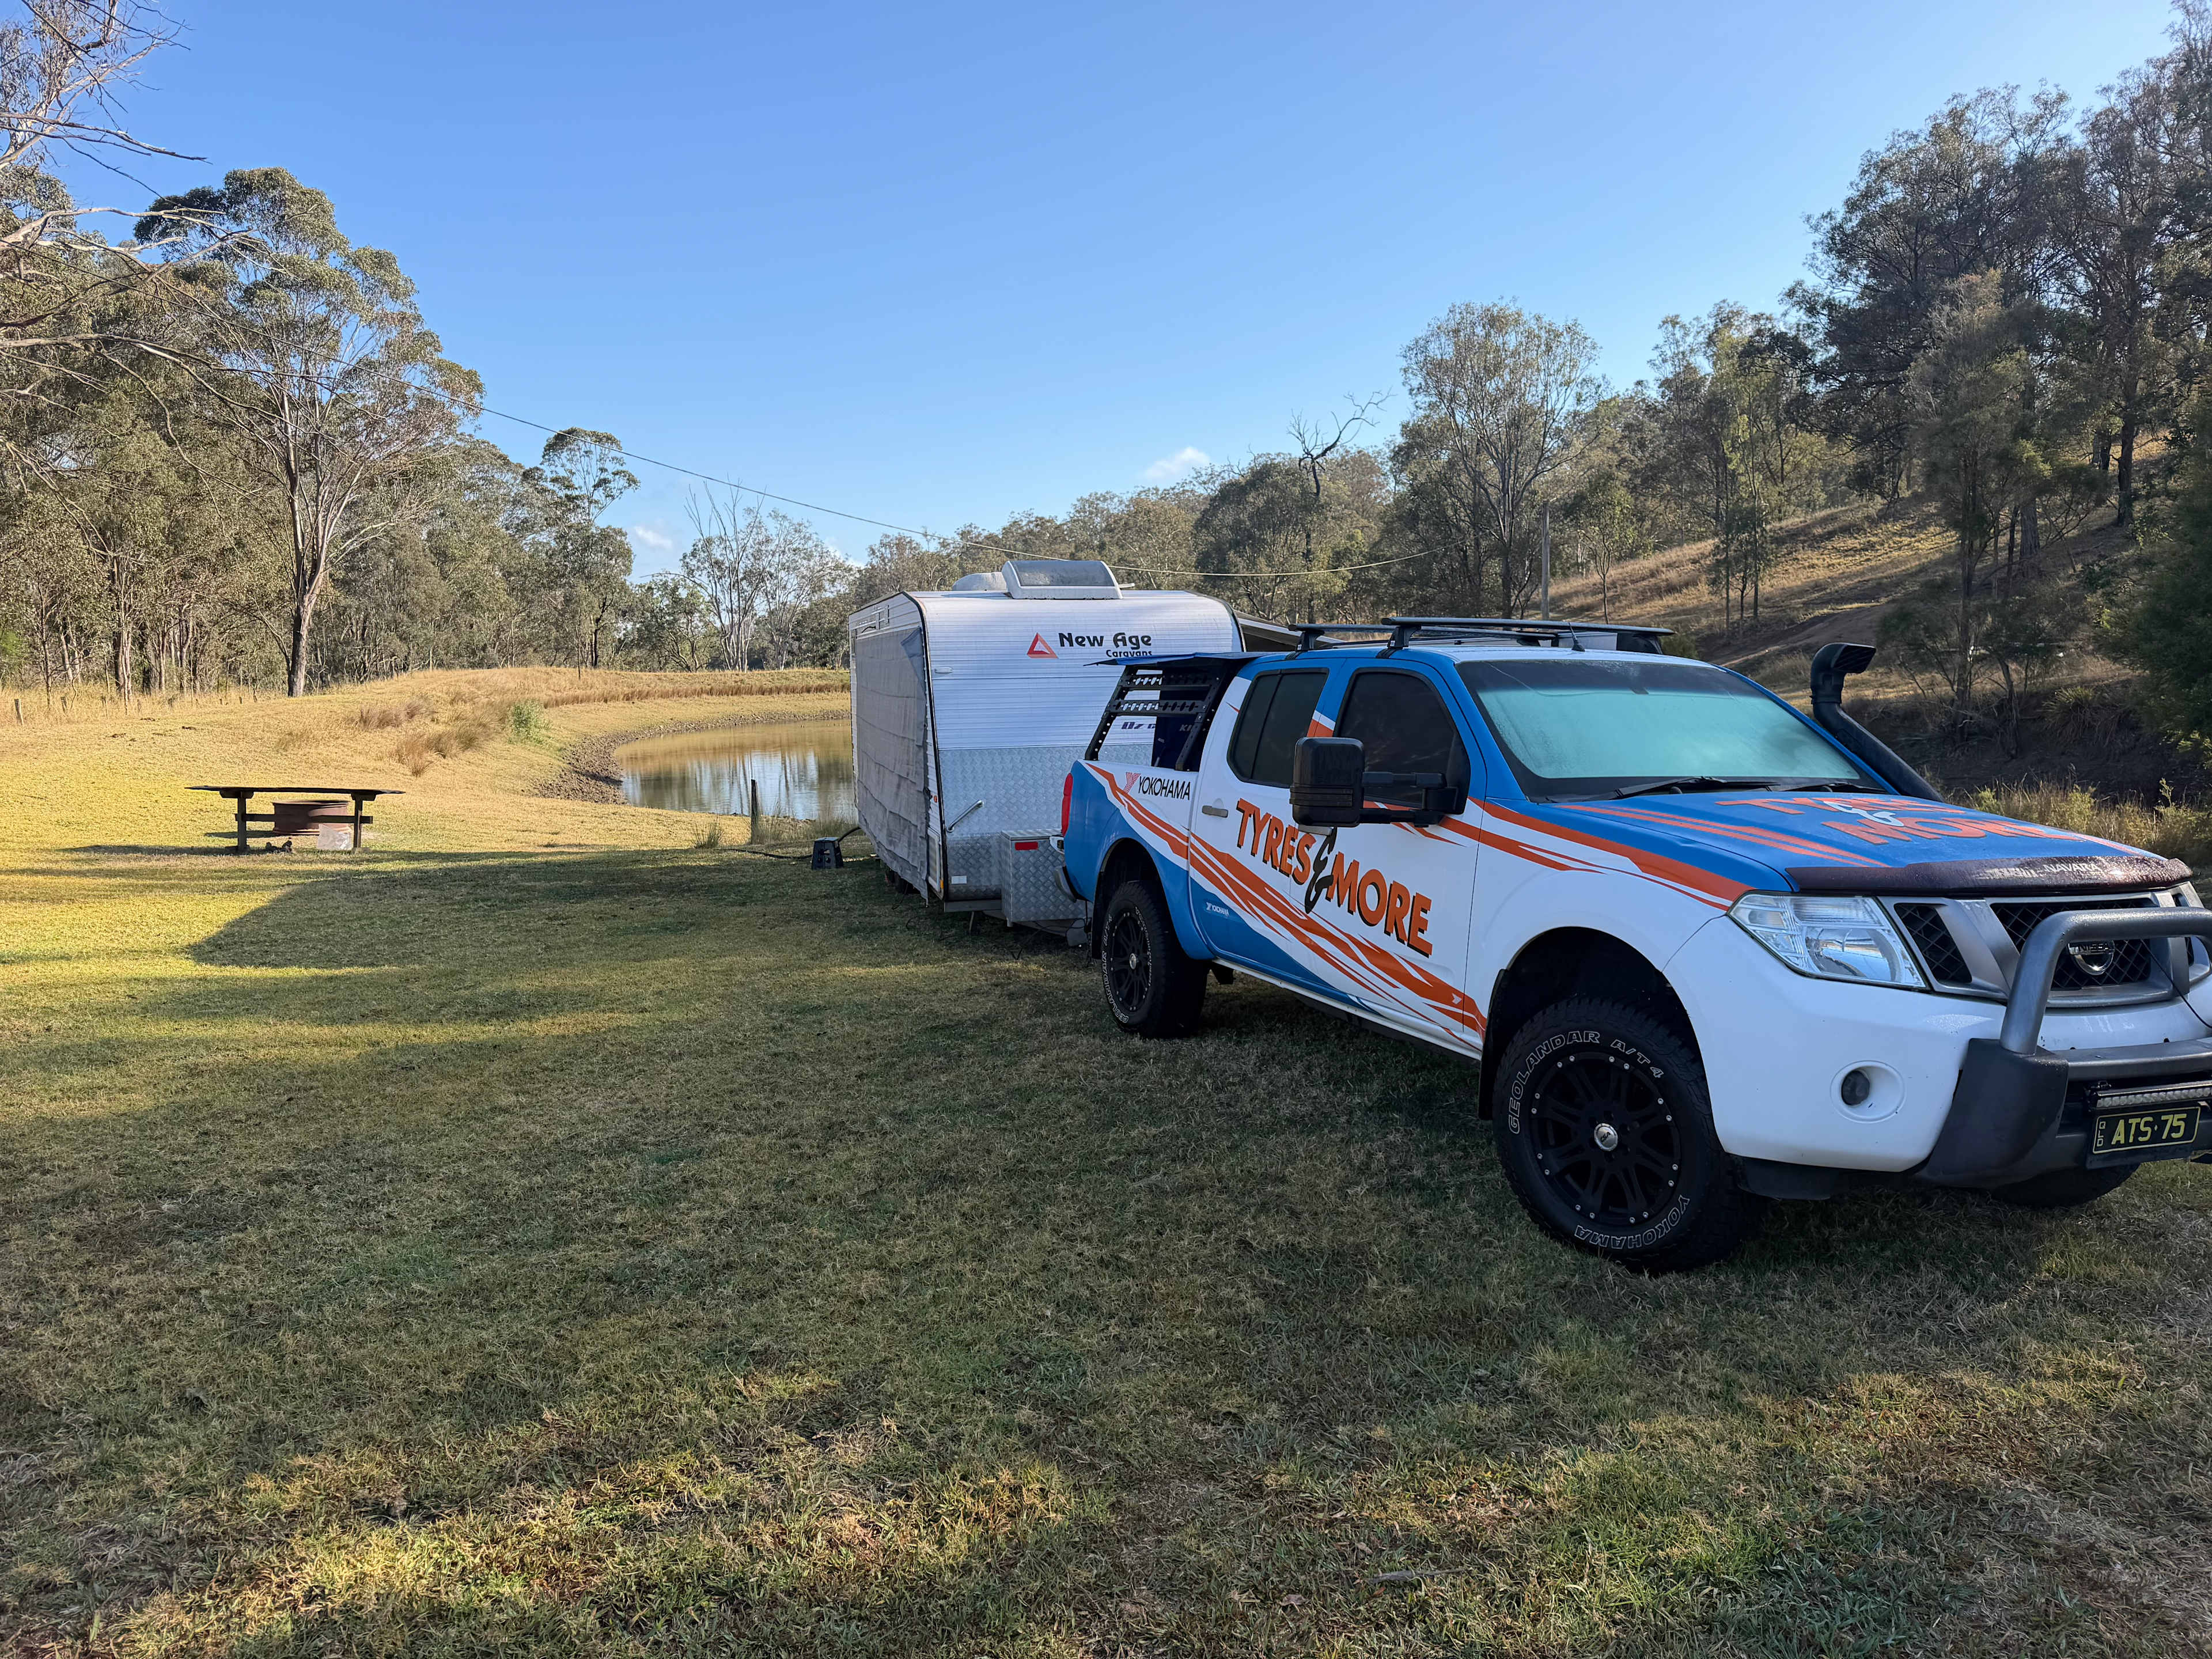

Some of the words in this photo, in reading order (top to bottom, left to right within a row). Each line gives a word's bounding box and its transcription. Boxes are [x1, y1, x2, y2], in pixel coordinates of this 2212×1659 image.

[1058, 632, 1104, 647] New
[1113, 632, 1152, 650] Age
[1106, 649, 1152, 658] Caravans
[1138, 776, 1191, 801] YOKOHAMA
[1236, 798, 1317, 885] TYRES
[1325, 851, 1433, 958] MORE
[2043, 863, 2101, 873] NAVARA
[1509, 1031, 1600, 1134] GEOLANDAR
[1574, 1195, 1690, 1249] YOKOHAMA
